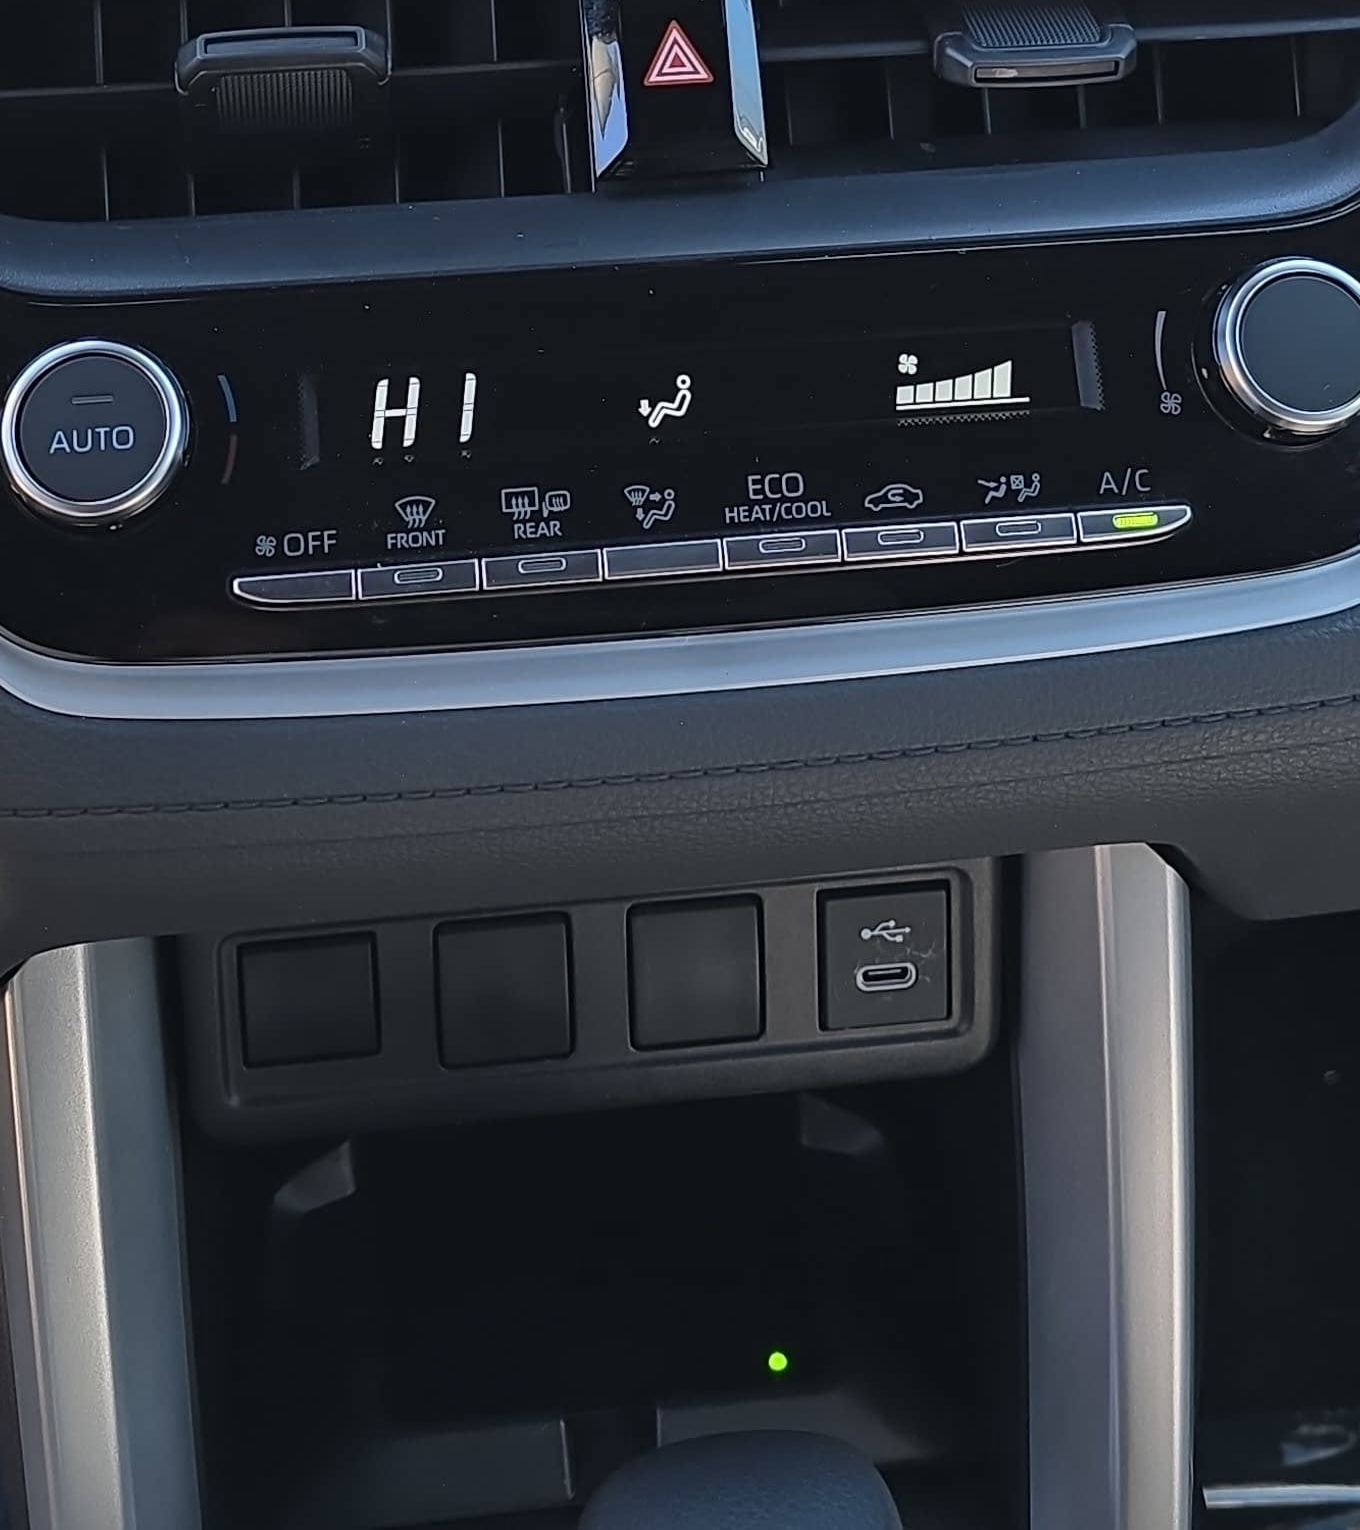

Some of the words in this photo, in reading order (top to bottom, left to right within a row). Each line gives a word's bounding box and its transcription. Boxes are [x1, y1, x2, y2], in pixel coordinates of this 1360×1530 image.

[49, 425, 136, 455] AUTO
[747, 472, 805, 499] ECO
[1099, 468, 1152, 496] A/C
[724, 502, 831, 525] HEAT/COOL
[283, 530, 338, 557] OFF
[386, 529, 446, 550] FRONT
[513, 520, 563, 540] REAR
